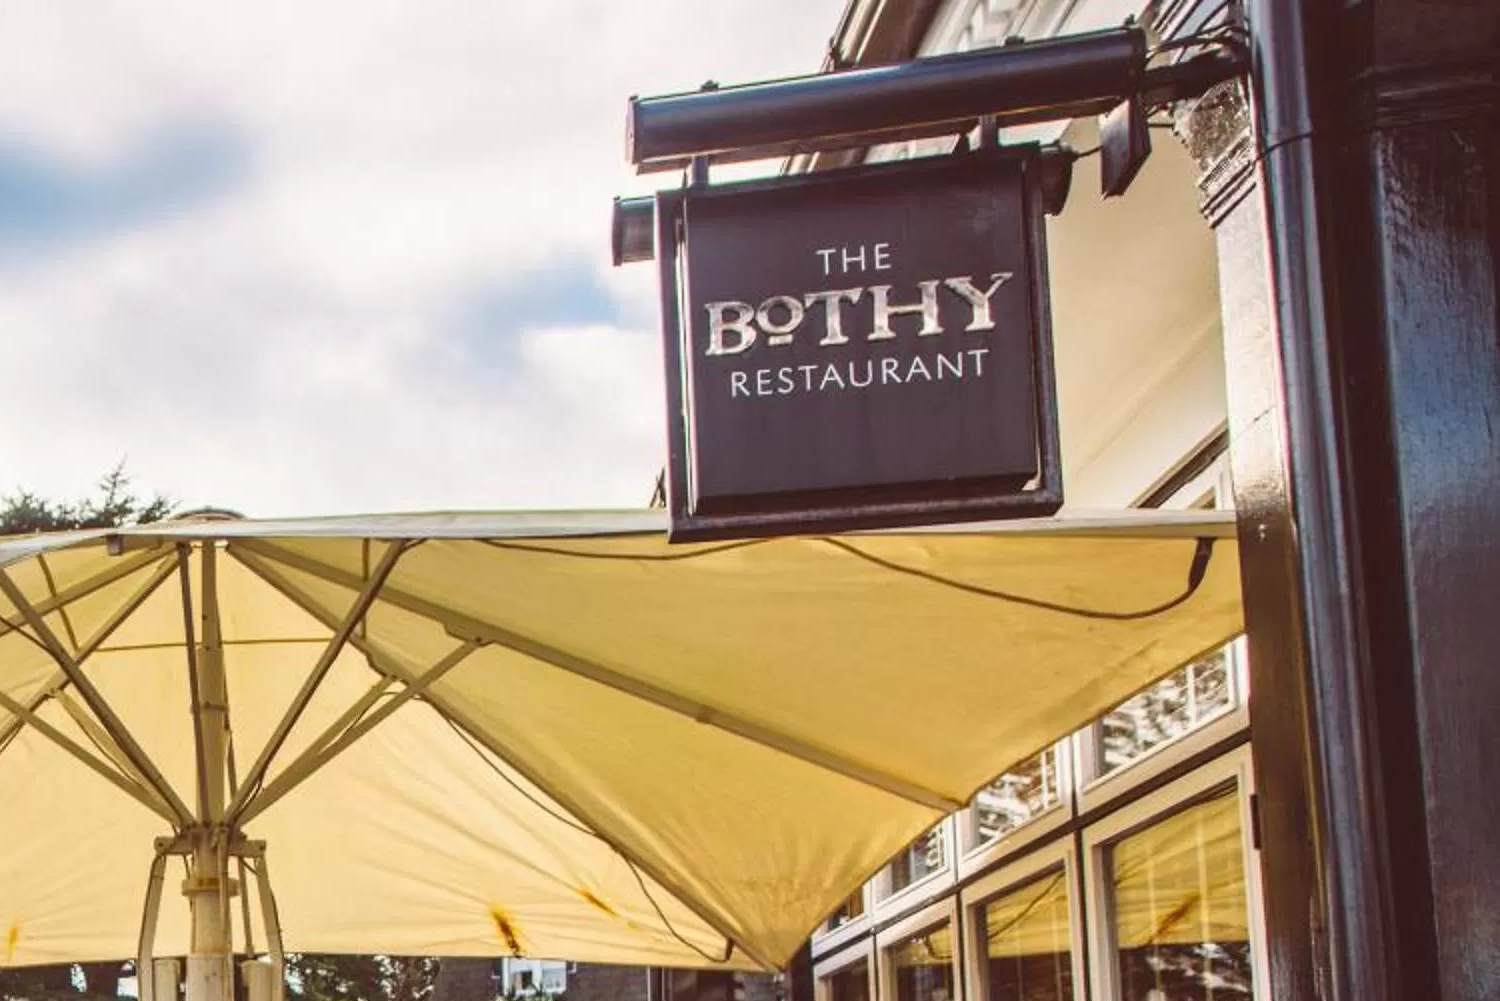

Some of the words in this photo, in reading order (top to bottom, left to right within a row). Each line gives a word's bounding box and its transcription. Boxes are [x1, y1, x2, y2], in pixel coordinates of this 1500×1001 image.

[816, 243, 892, 275] THE
[704, 272, 1013, 356] BOTHY
[731, 349, 990, 397] RESTAURANT
